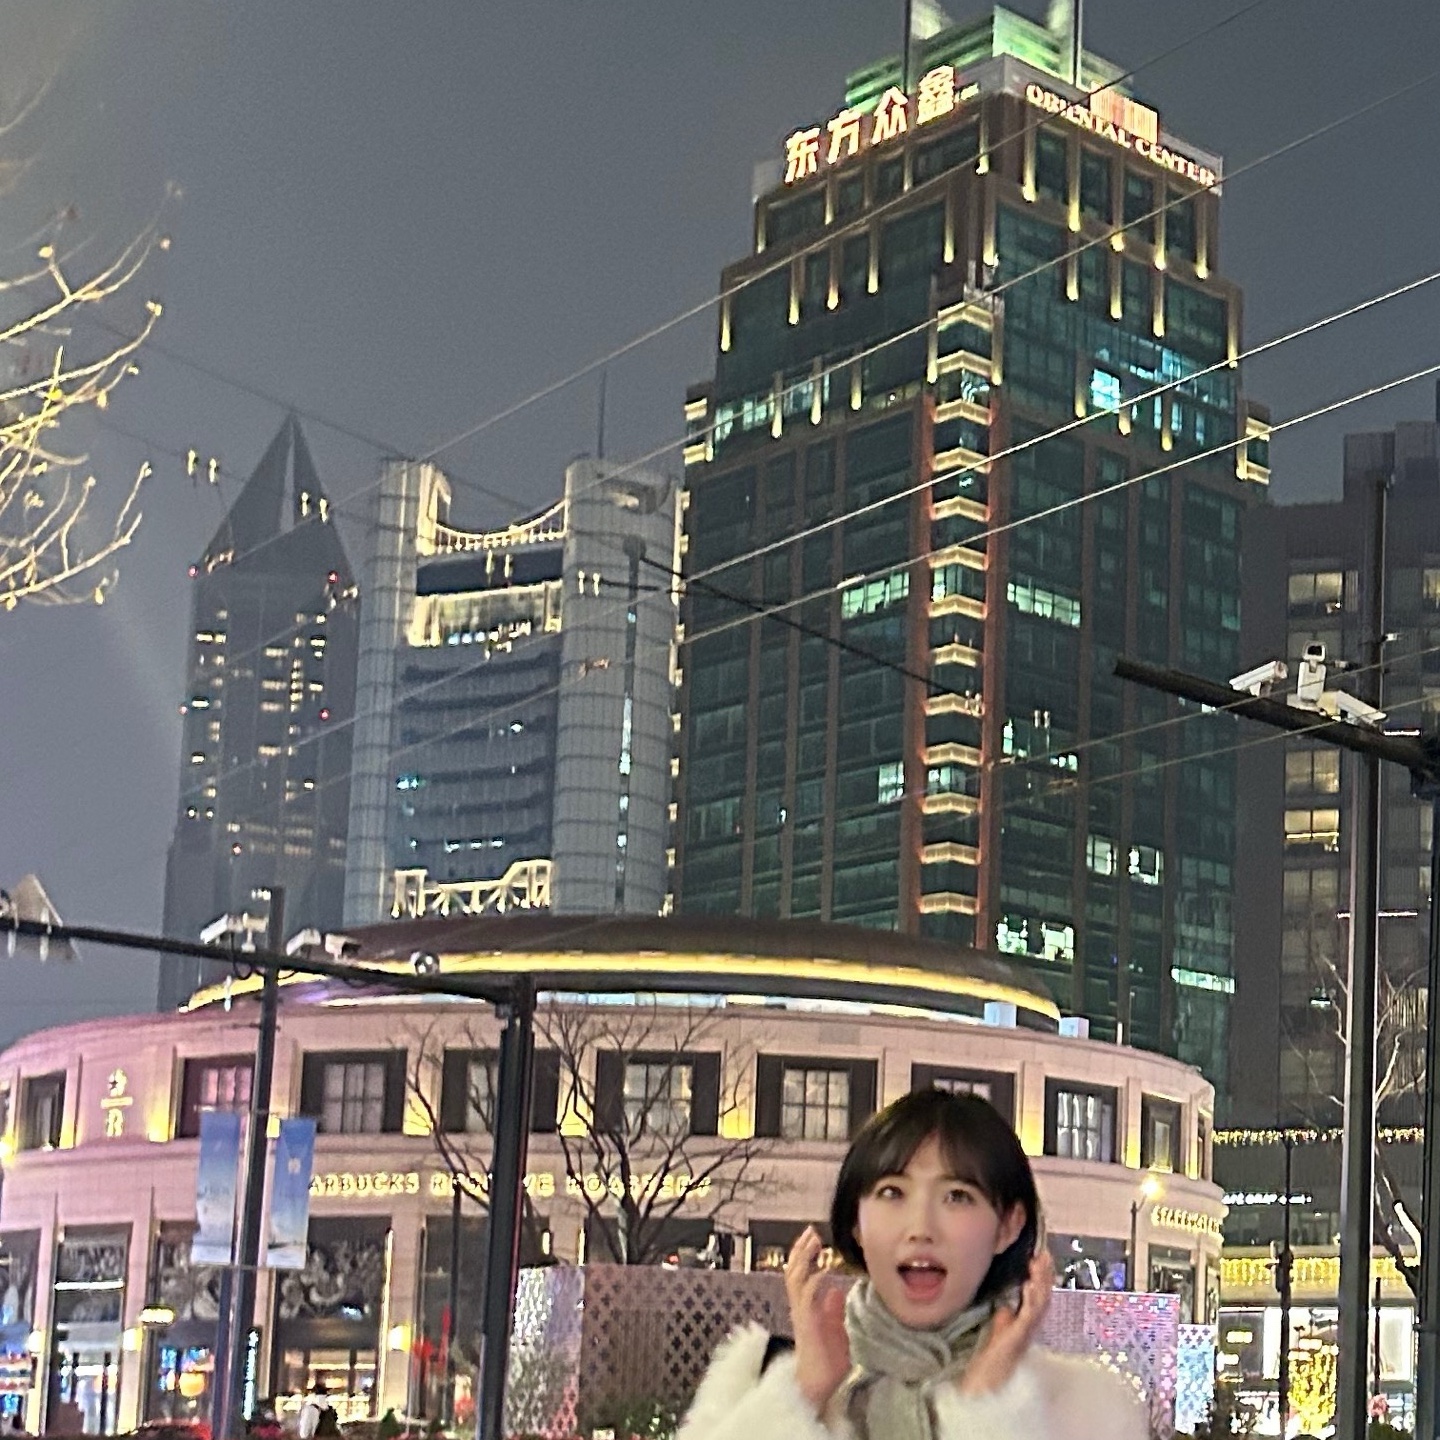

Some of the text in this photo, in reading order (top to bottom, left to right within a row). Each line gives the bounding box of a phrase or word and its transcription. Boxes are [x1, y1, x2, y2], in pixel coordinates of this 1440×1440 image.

[784, 64, 955, 184] 东方众鑫
[1026, 83, 1216, 187] ORIENTAL CENTER
[308, 1172, 419, 1197] ARBUCKS
